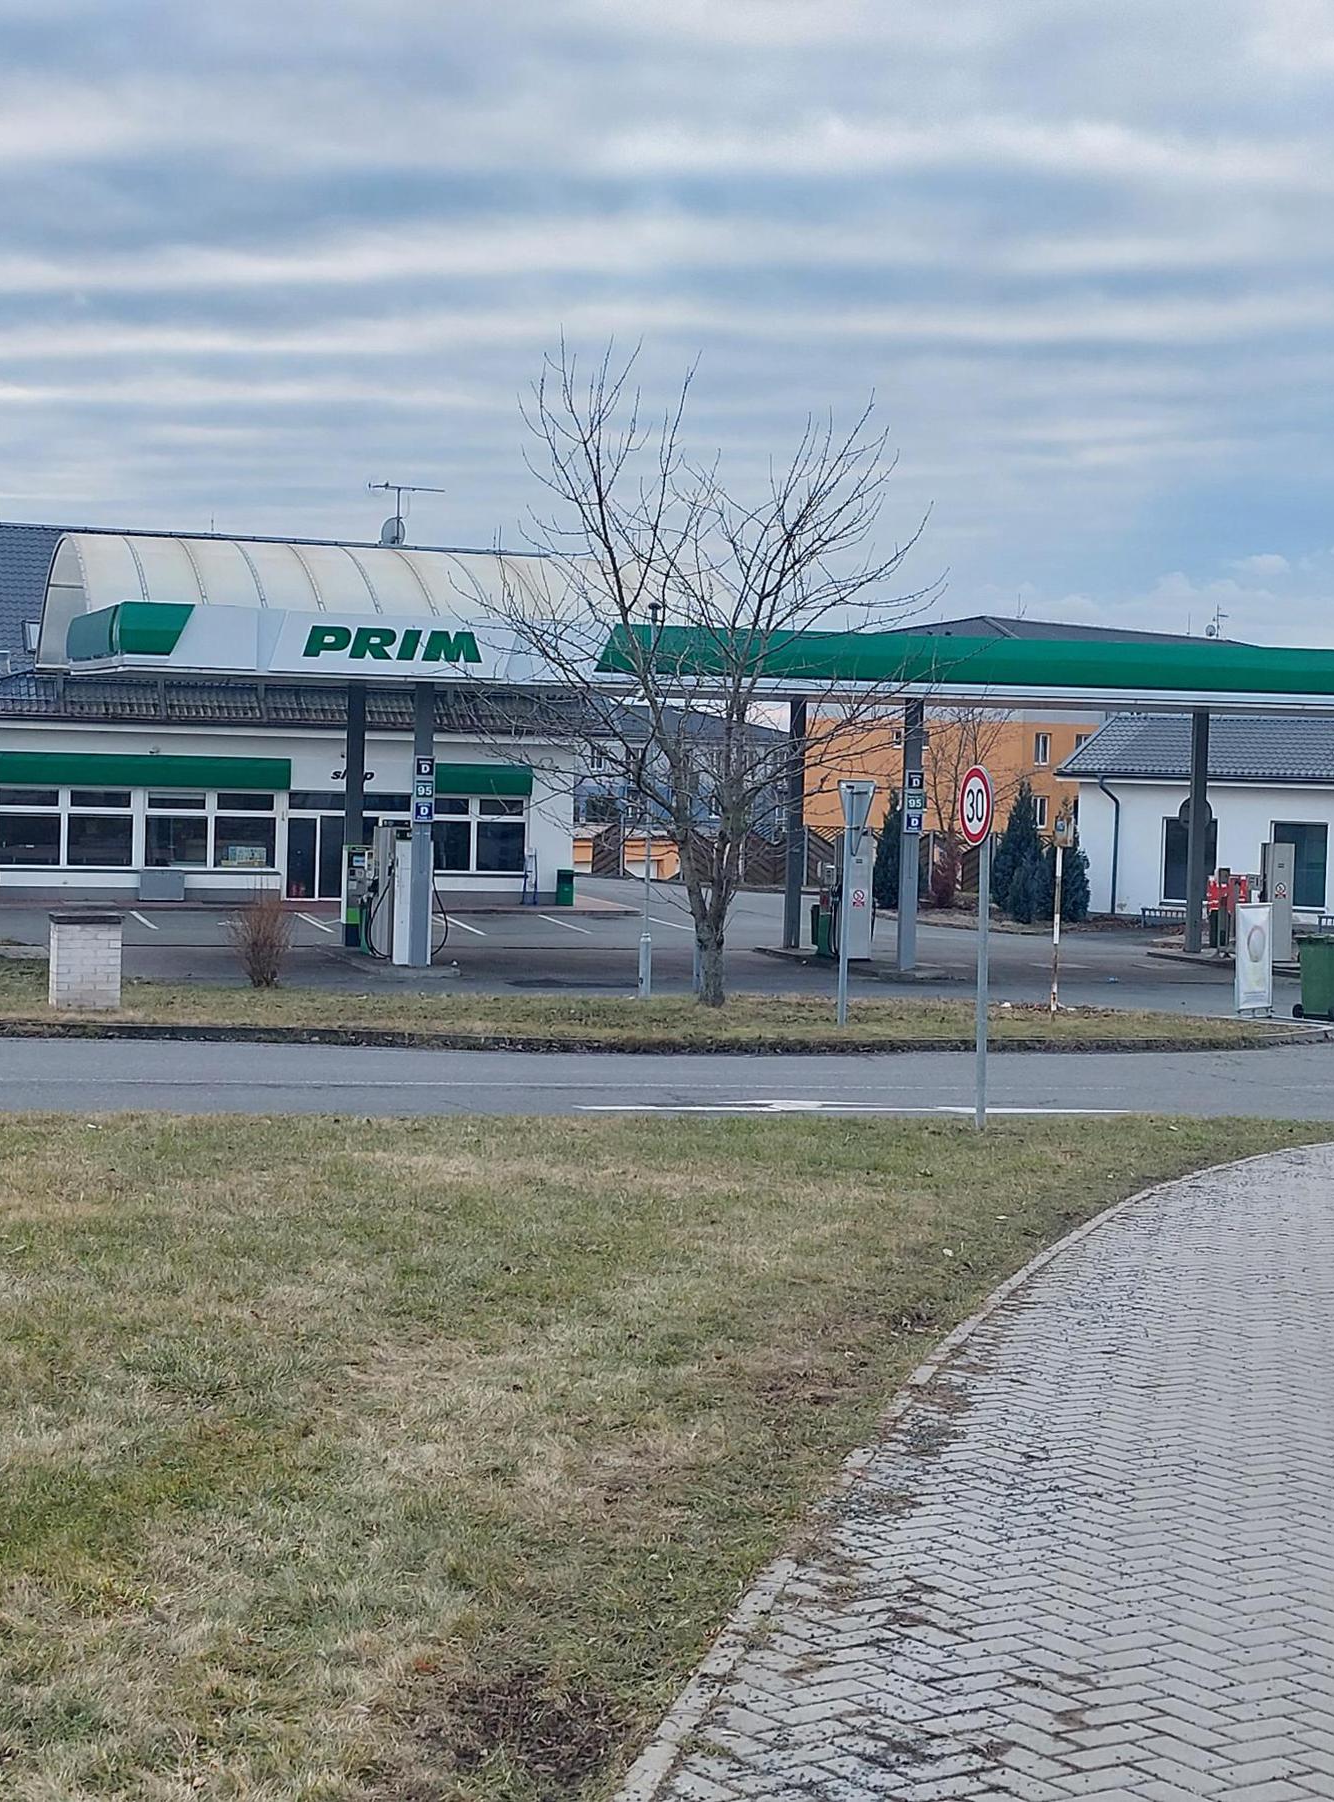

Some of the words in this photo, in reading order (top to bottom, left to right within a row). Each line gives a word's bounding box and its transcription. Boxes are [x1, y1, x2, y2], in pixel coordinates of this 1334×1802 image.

[302, 625, 483, 664] PRIM
[421, 764, 430, 774] D
[912, 778, 920, 787] D
[417, 785, 433, 796] 95
[908, 799, 922, 808] 95
[966, 788, 984, 824] 30
[420, 806, 429, 816] D
[910, 818, 919, 827] D
